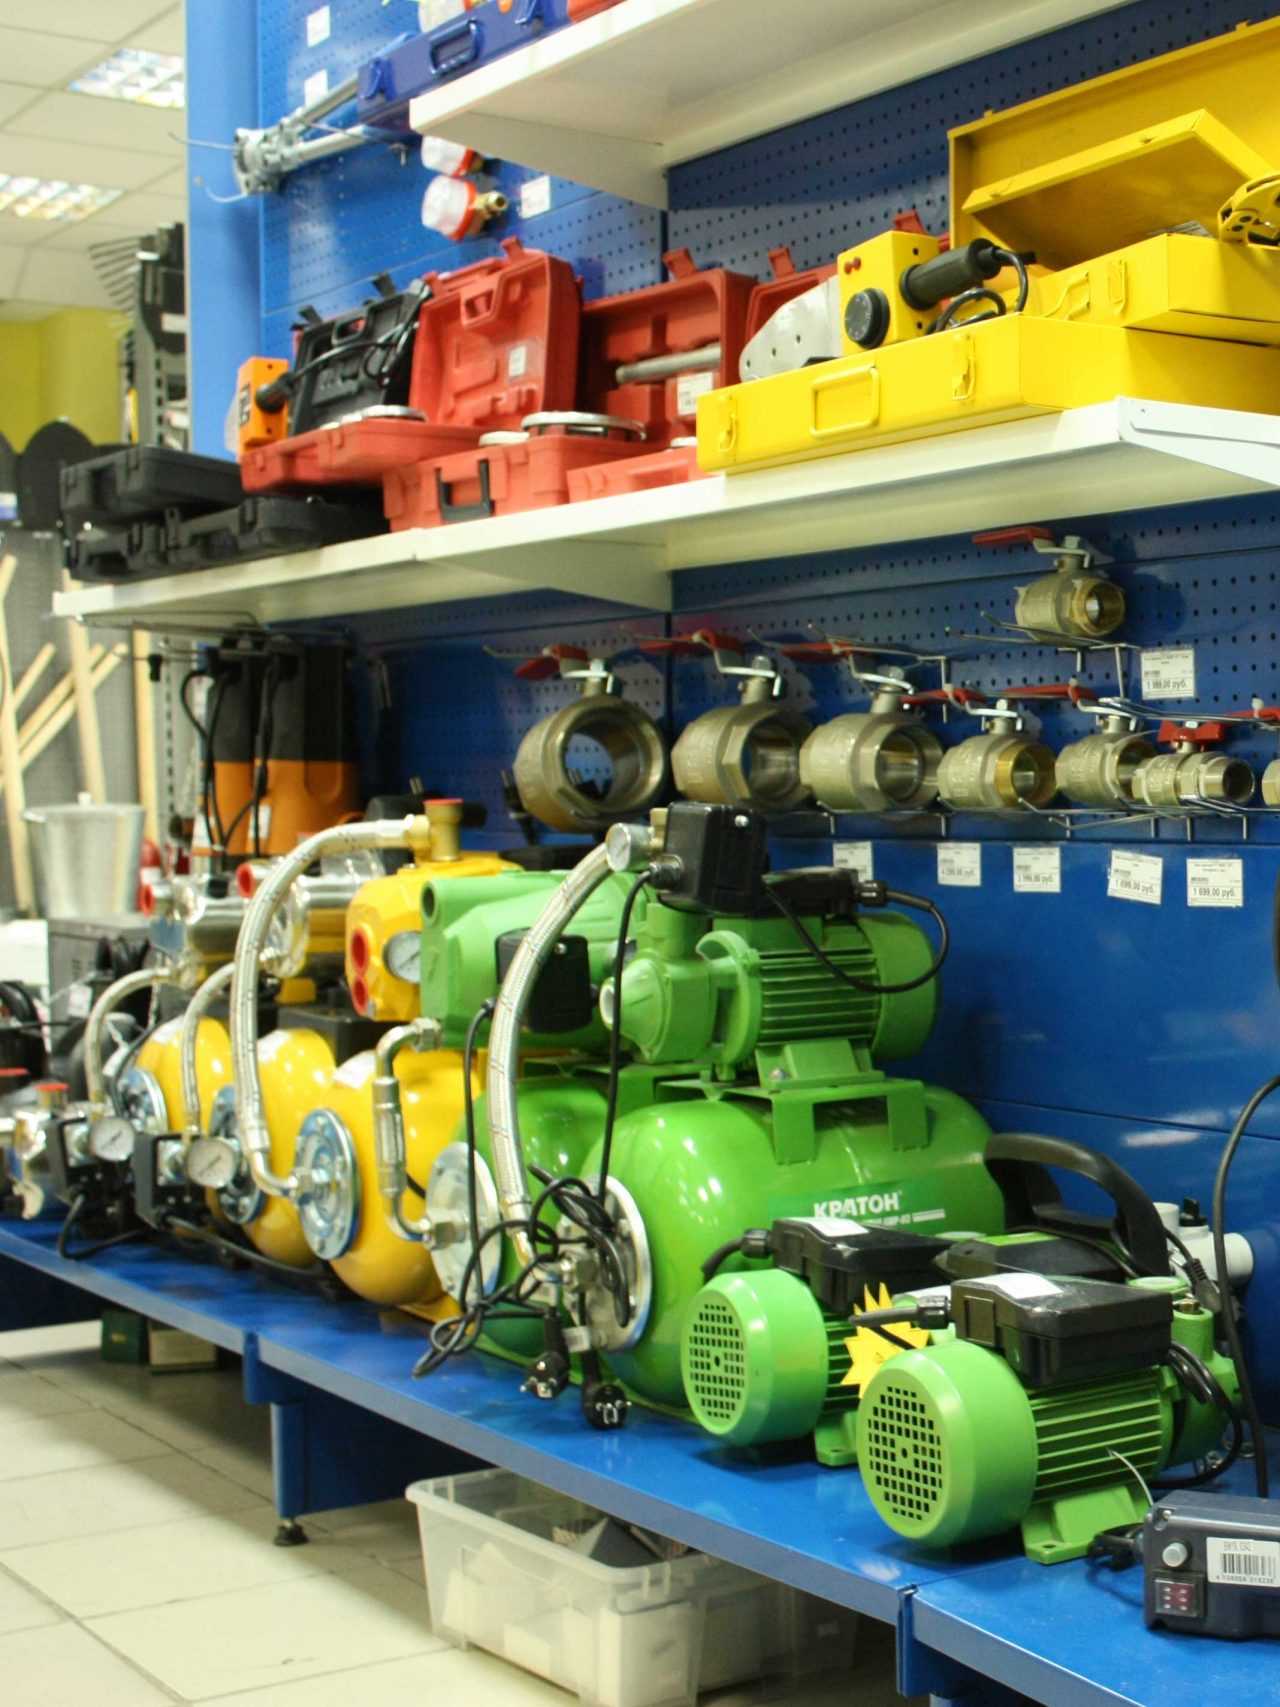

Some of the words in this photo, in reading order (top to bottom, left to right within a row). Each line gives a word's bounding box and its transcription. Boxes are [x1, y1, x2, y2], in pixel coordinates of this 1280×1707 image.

[1172, 679, 1187, 690] руб.
[1141, 883, 1155, 896] руб.
[1221, 888, 1236, 899] руб.
[813, 1193, 900, 1219] КРАТОН
